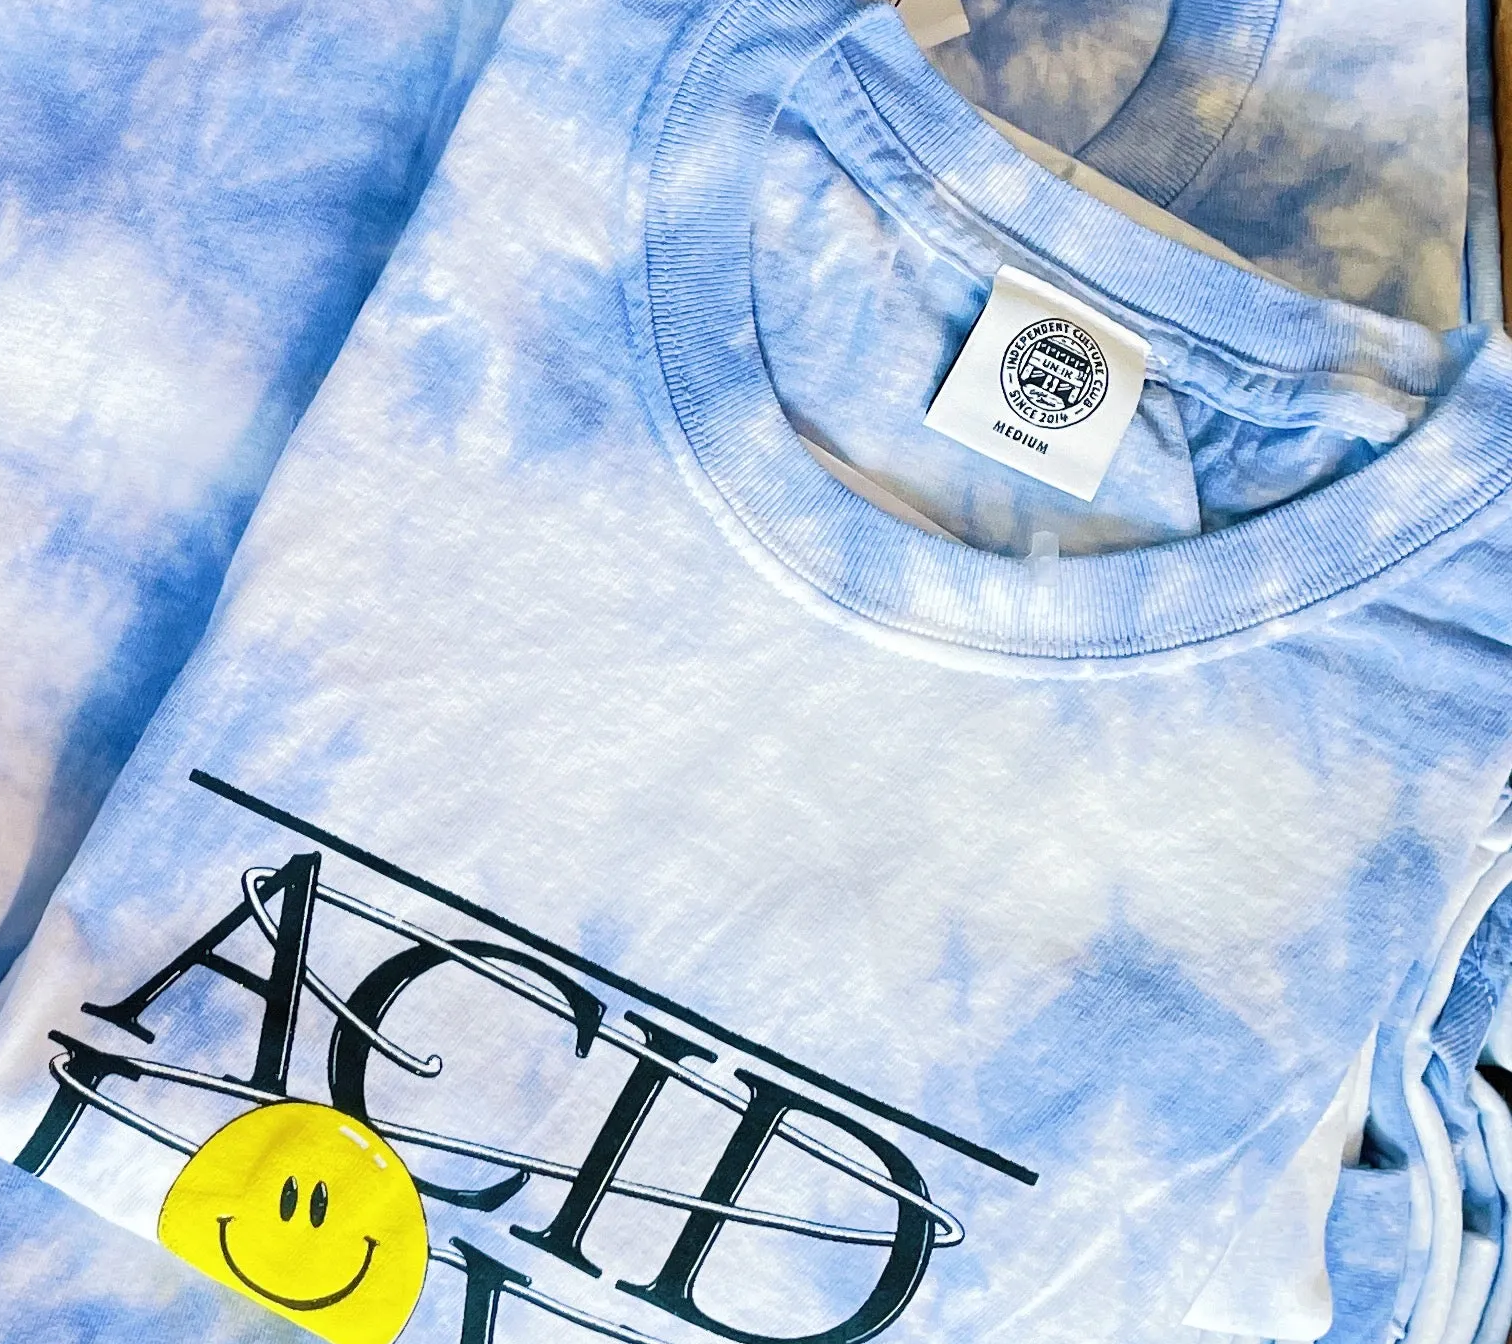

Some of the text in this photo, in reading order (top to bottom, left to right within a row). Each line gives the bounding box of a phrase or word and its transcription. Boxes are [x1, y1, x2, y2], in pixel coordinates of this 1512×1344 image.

[1006, 321, 1070, 370] INDEPENDENT
[1072, 329, 1105, 375] CULTURE
[1008, 389, 1036, 419] SINCE
[1038, 412, 1069, 424] 2014
[1083, 379, 1104, 409] CLUB
[992, 420, 1049, 455] MEDIUM
